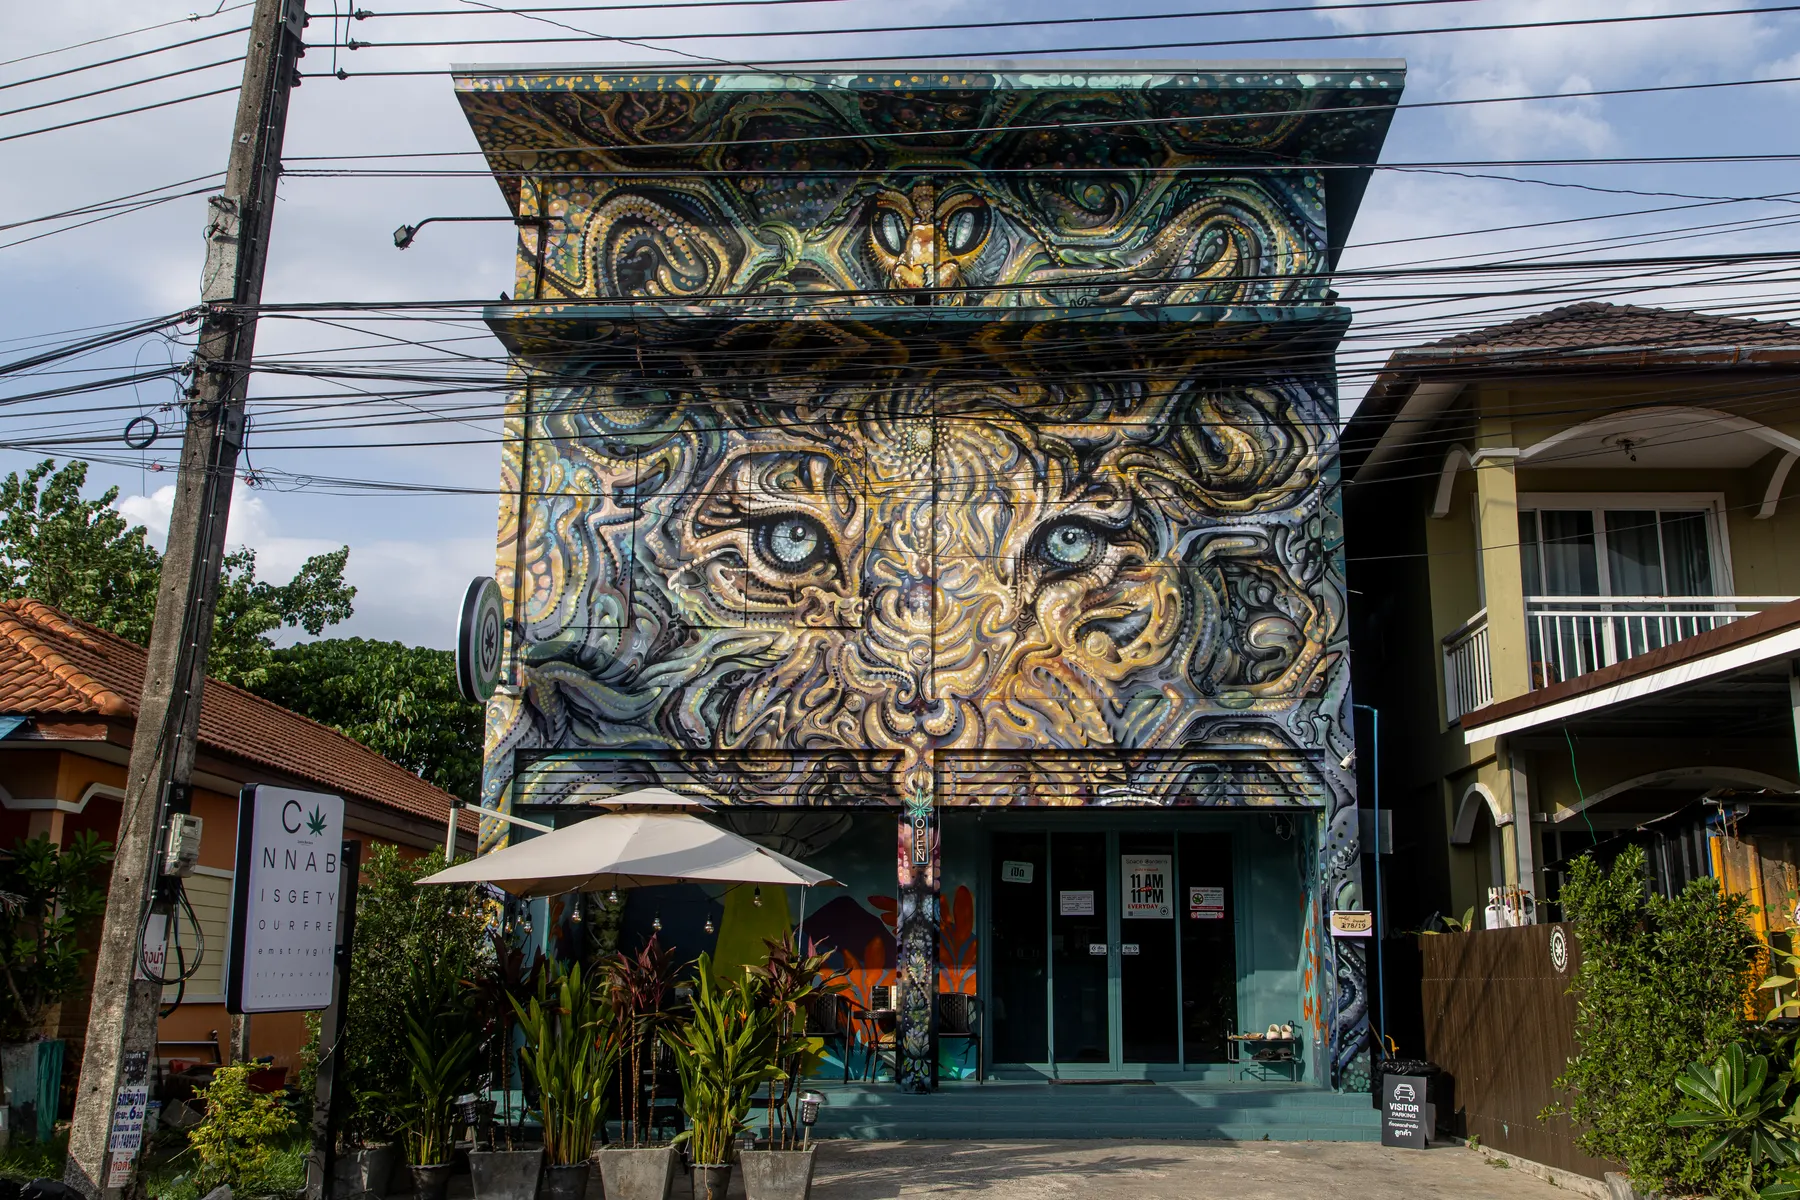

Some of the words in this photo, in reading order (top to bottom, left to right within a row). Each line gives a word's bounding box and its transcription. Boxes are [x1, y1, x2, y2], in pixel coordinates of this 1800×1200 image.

[282, 799, 302, 834] C
[915, 818, 925, 862] OPEN
[1130, 874, 1141, 888] 11
[1145, 874, 1163, 888] AM
[1130, 889, 1141, 903] 11
[1145, 889, 1164, 903] PM
[1389, 1102, 1419, 1112] VISITOR
[1394, 1129, 1412, 1138] ลูกค้า
